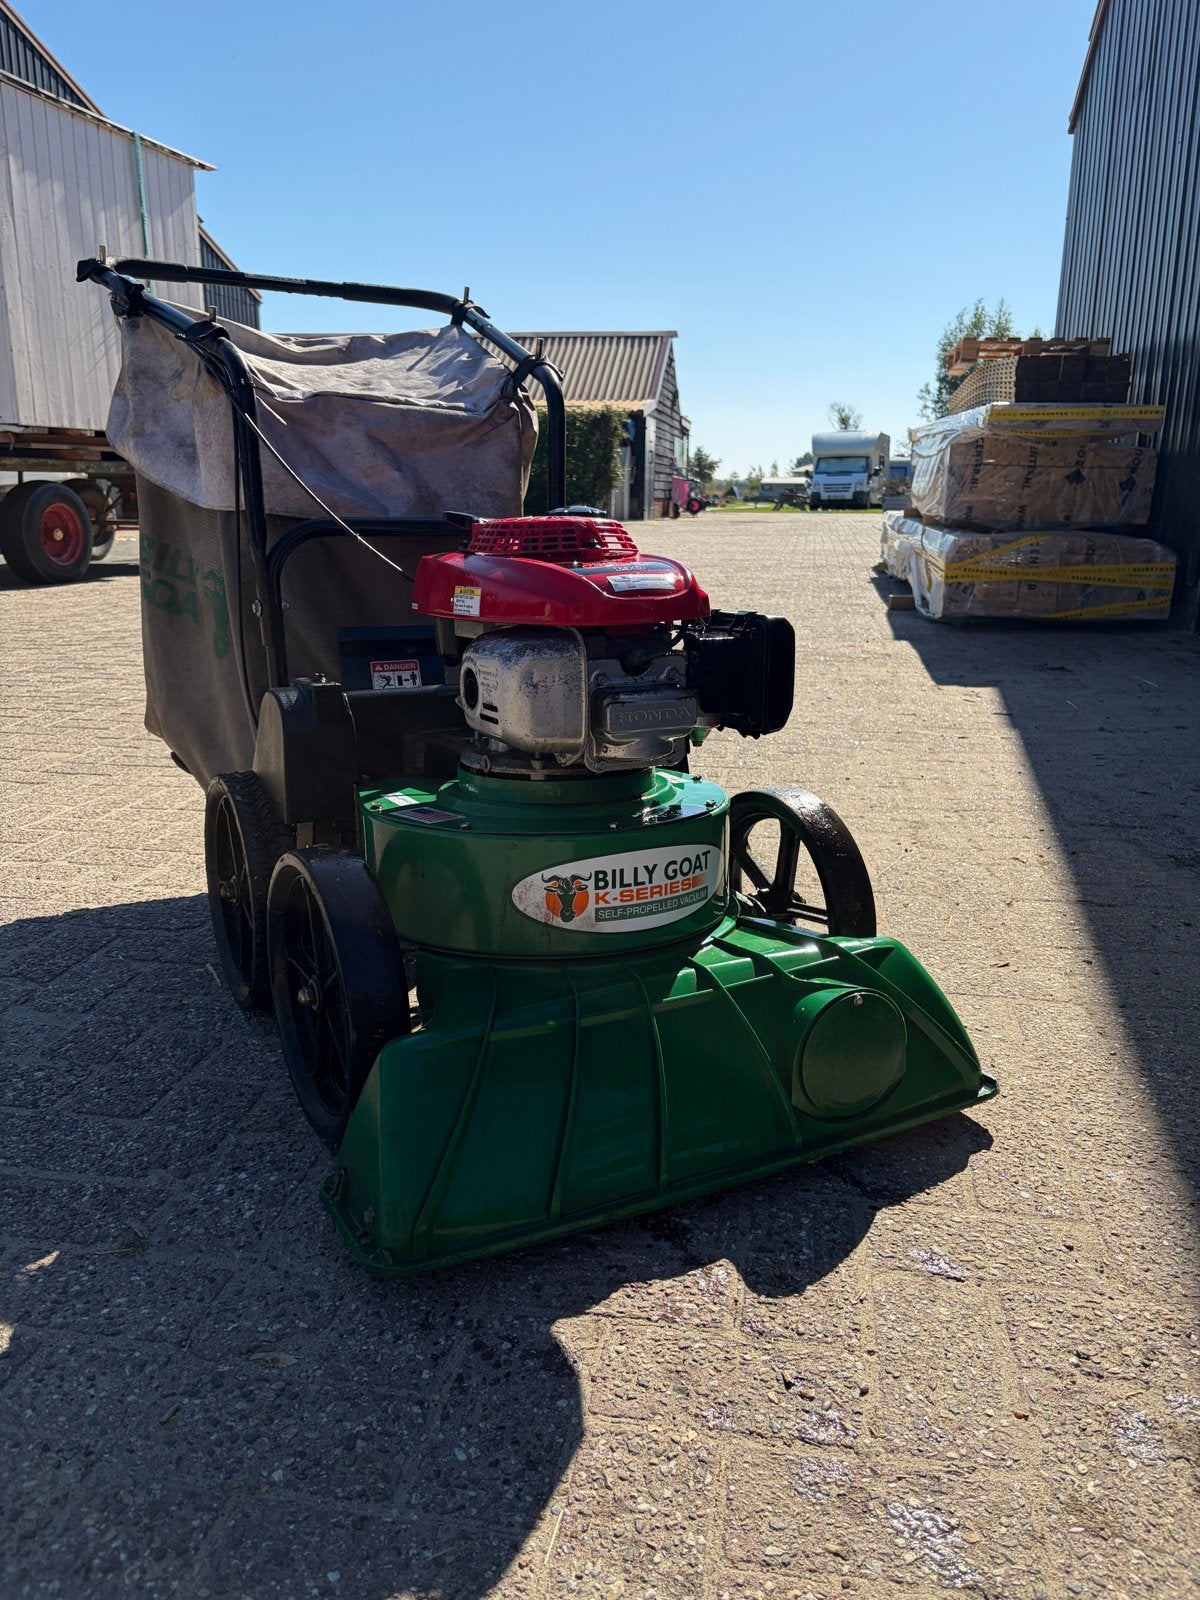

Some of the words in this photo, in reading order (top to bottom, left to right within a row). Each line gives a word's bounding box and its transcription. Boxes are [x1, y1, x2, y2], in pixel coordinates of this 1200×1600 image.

[383, 662, 416, 671] DANGER
[616, 706, 693, 725] HONDA
[594, 863, 659, 891] BILLY
[664, 850, 711, 881] GOAT
[594, 878, 693, 906] K-SERIES
[598, 898, 679, 920] SELF-PROPELLED
[680, 889, 708, 907] VACUUM
